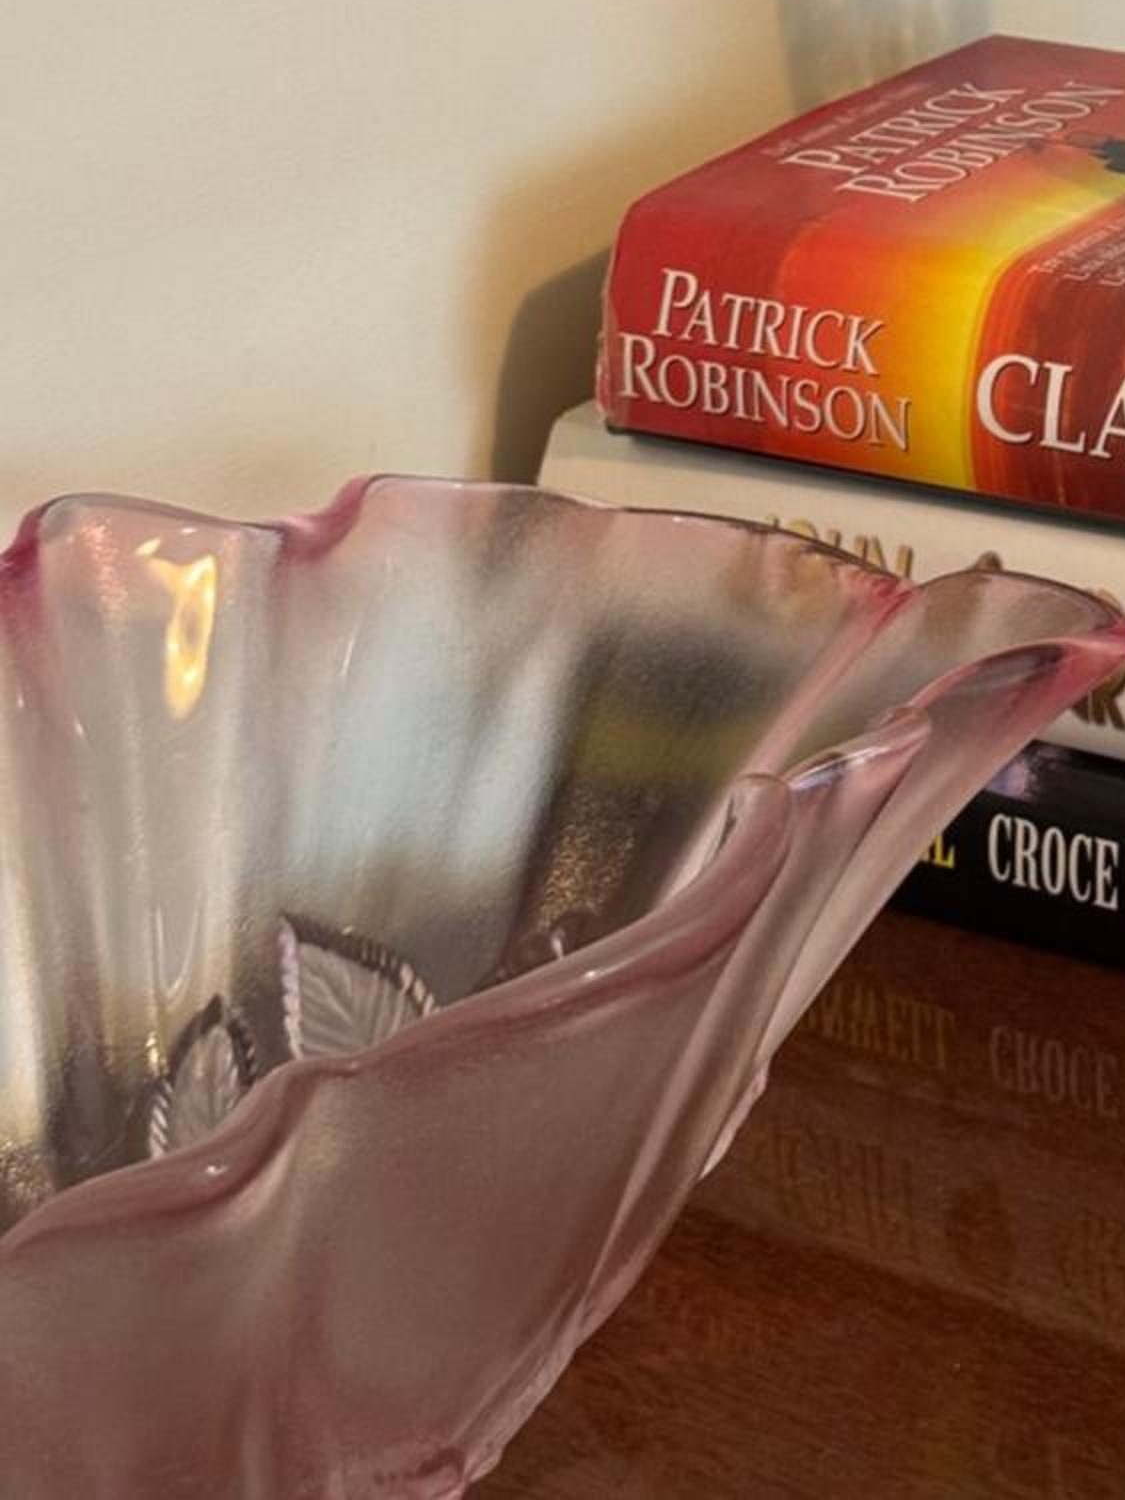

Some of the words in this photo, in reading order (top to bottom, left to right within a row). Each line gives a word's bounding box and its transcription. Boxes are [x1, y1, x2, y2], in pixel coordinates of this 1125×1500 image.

[779, 82, 1025, 174] PATRICK
[835, 80, 1125, 201] ROBINSON
[652, 267, 884, 376] PATRICK
[619, 332, 912, 451] ROBINSON
[987, 813, 1119, 911] CROCE
